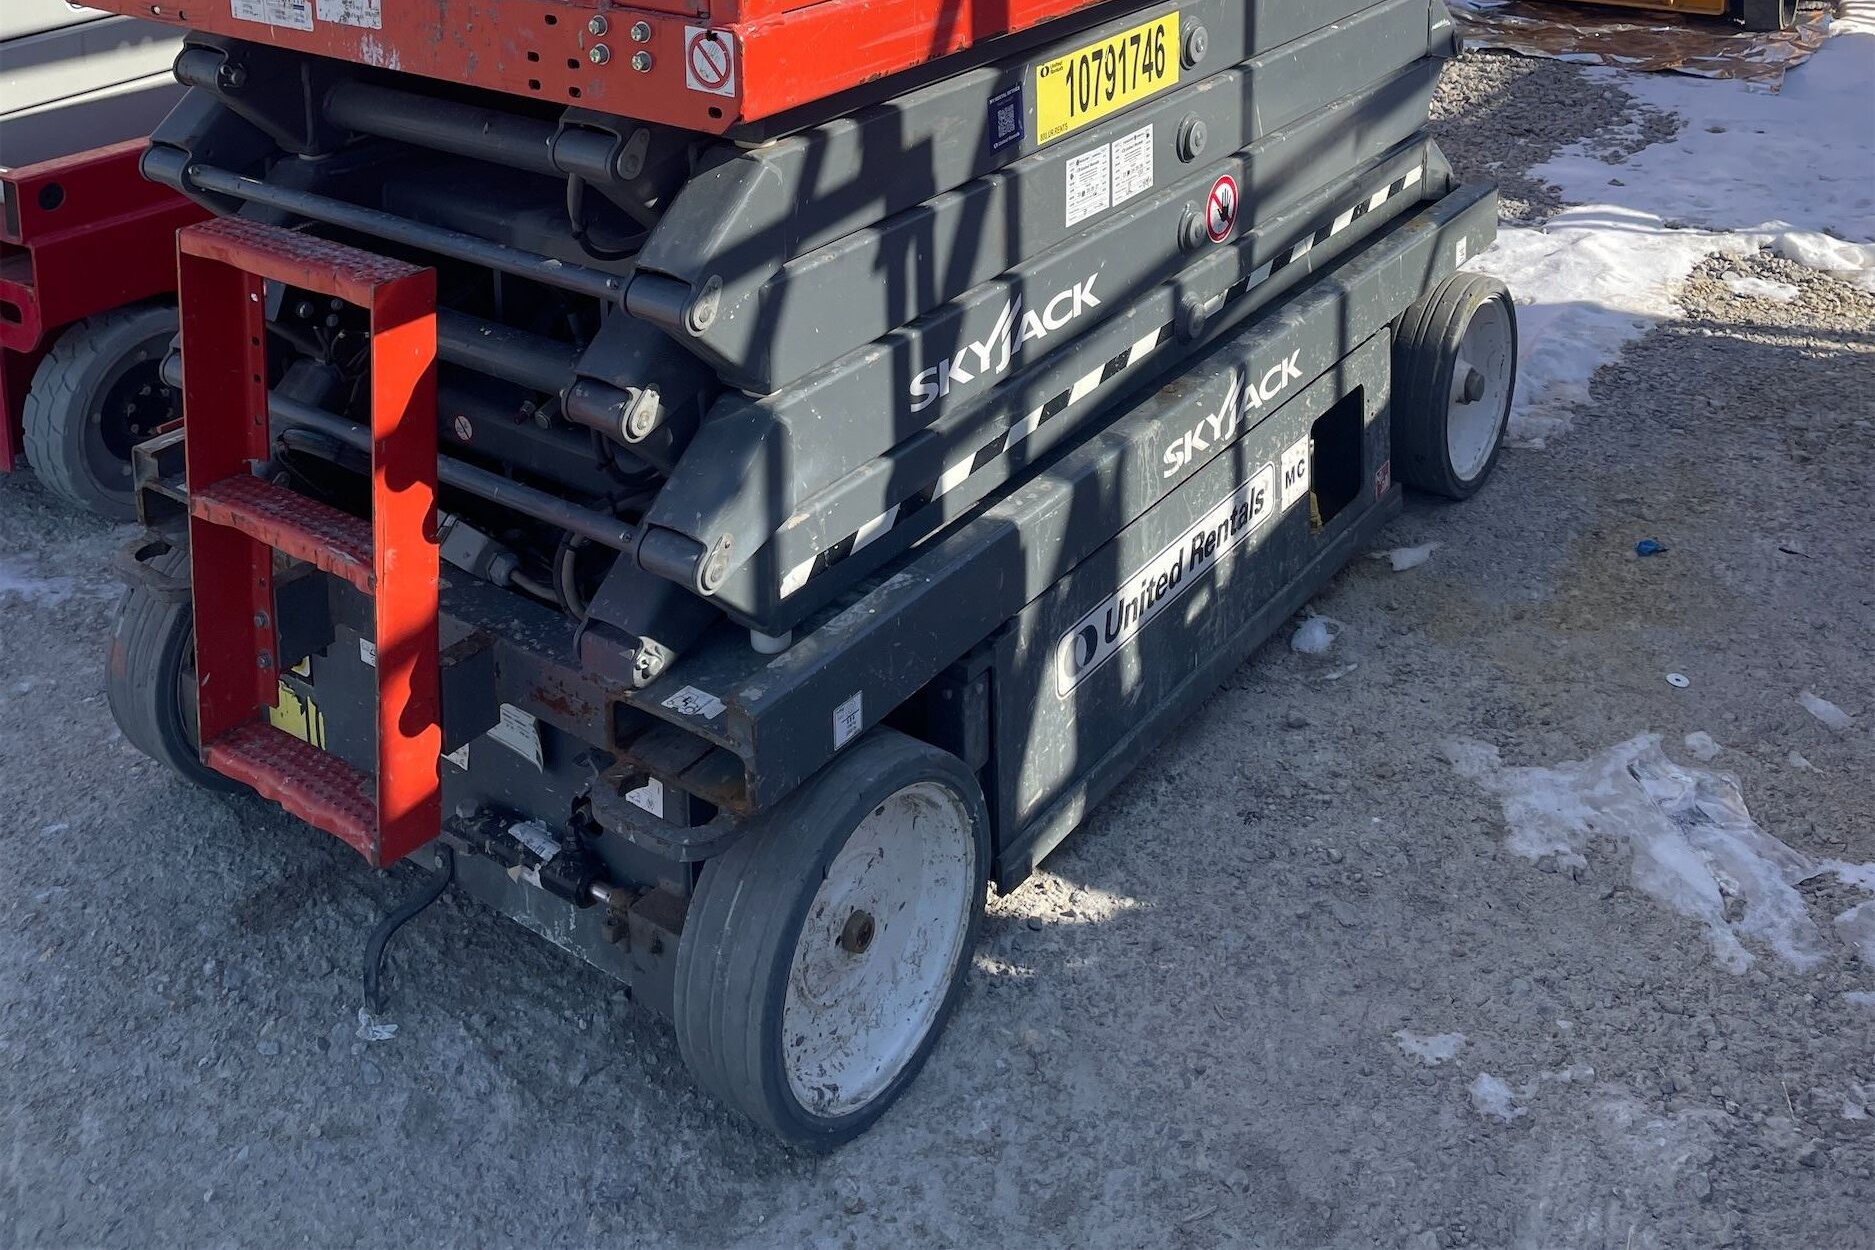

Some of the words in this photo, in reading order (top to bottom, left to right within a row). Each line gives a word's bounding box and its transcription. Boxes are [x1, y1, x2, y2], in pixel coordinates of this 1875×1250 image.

[1066, 24, 1165, 118] 10791746
[909, 272, 1102, 413] SKYJACK
[1163, 348, 1304, 479] SKYJACK
[1285, 458, 1306, 490] MC
[1105, 546, 1184, 644] United
[1189, 487, 1265, 572] Rentals
